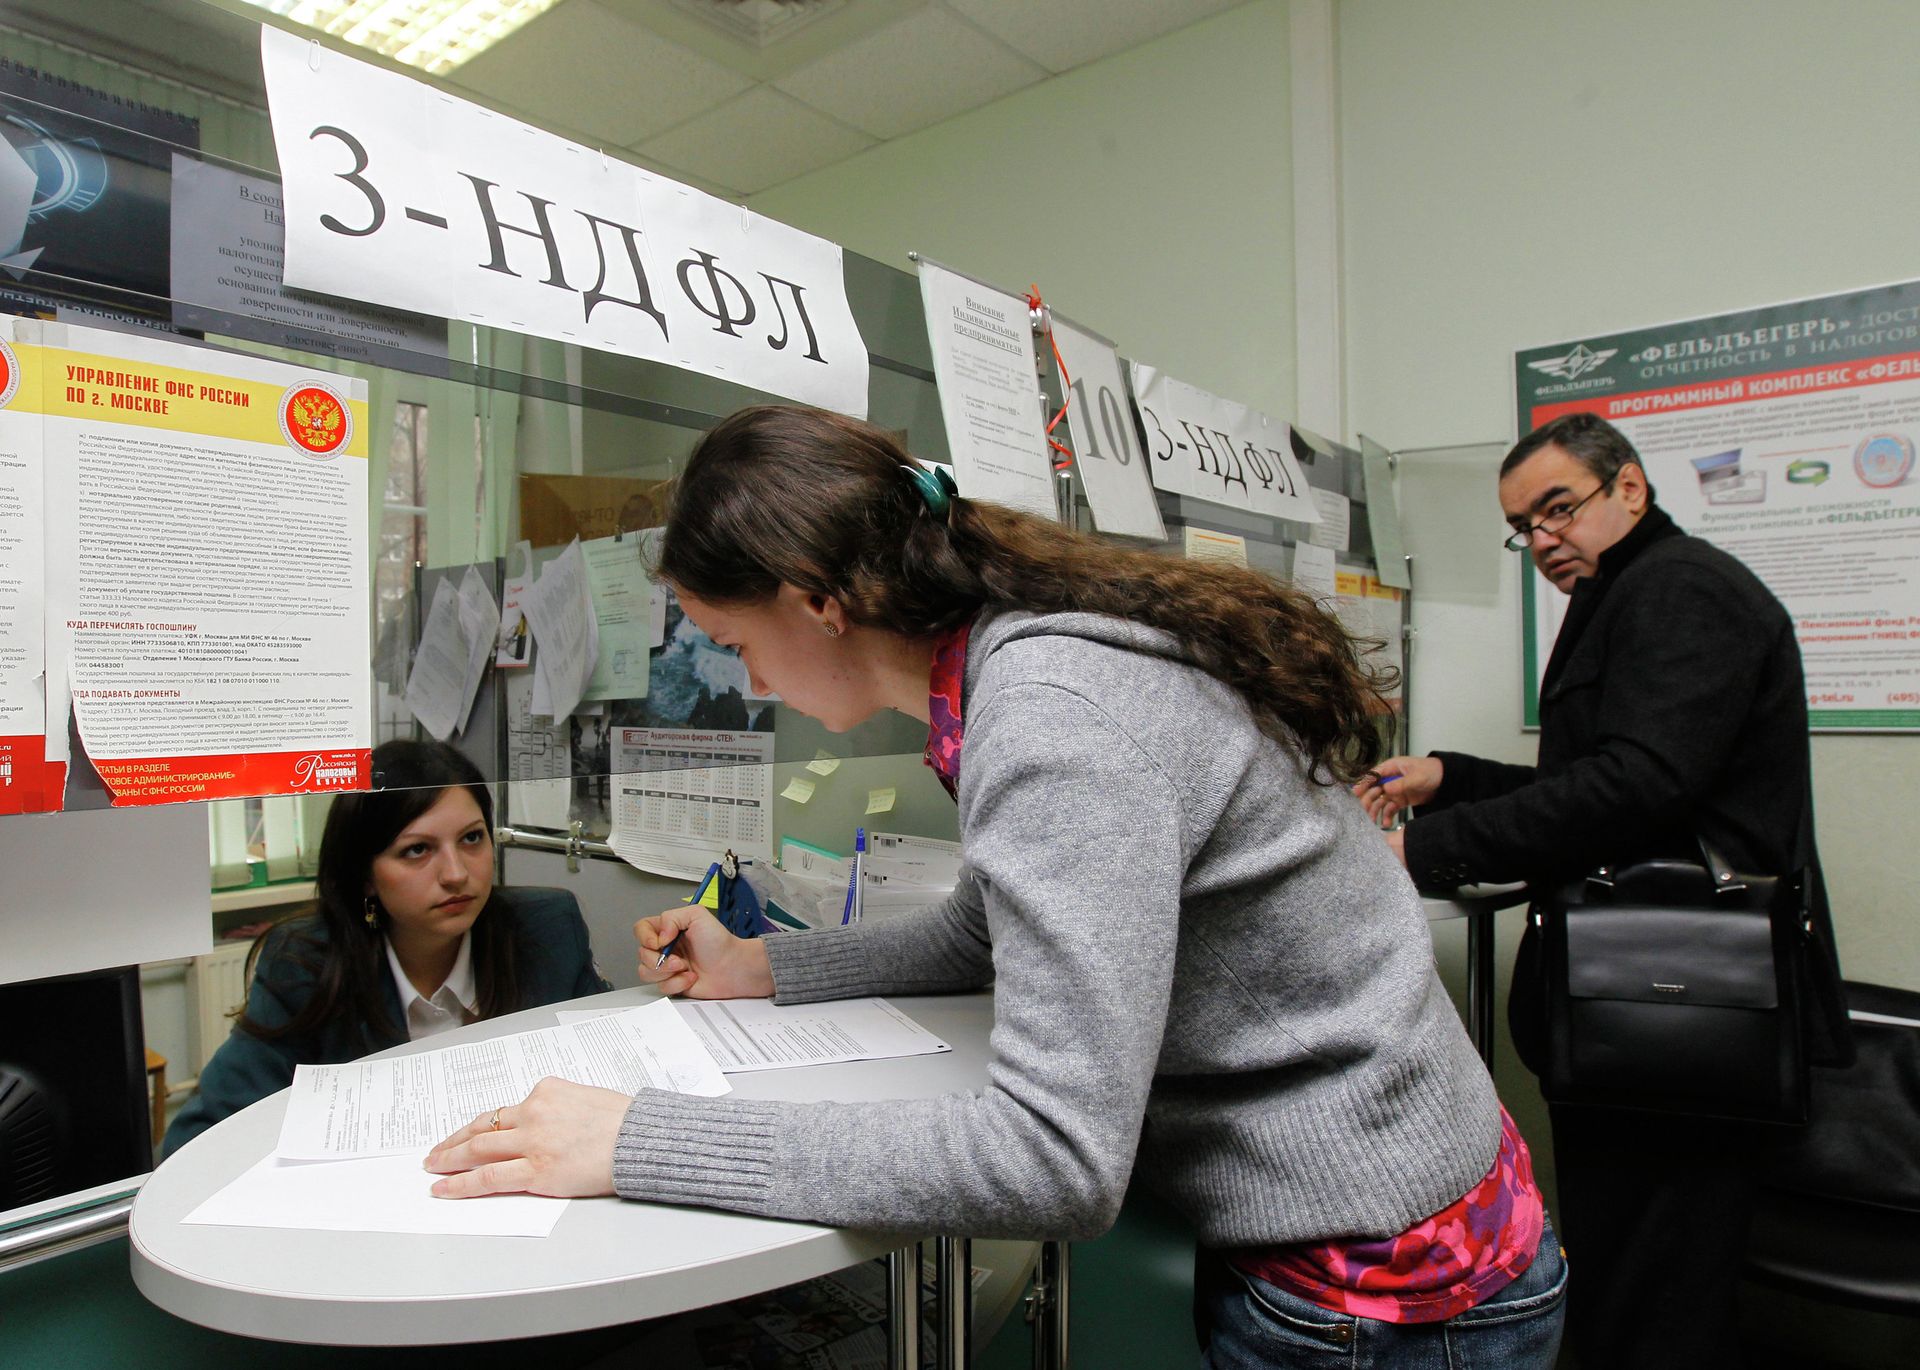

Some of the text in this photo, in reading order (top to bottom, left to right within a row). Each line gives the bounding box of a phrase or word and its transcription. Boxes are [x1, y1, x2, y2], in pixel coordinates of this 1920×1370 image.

[240, 186, 249, 198] В
[264, 208, 284, 223] На
[310, 124, 829, 364] 3-НДФЛ
[218, 276, 276, 296] основании
[238, 295, 314, 318] доверенности
[316, 311, 336, 323] или
[338, 316, 408, 338] доверенности,
[952, 306, 1020, 339] Индивидуальные
[966, 296, 1005, 320] Внимание
[954, 323, 1023, 354] предприниматели
[1629, 317, 1850, 363] «ФЕЛЬДЪЕГЕРЬ»
[1640, 348, 1772, 378] ОТЧЕТНОСТЬ
[1785, 344, 1796, 358] В
[66, 365, 250, 408] УПРАВЛЕНИЕ ФНС РОССИИ
[66, 386, 169, 415] ПО г. МОСКВЕ
[1610, 381, 1744, 414] ПРОГРАММНЫЙ
[1750, 368, 1850, 395] КОМПЛЕКС
[1070, 377, 1130, 466] 10
[1144, 406, 1298, 499] 3-НДФЛ
[66, 621, 197, 631] КУДА ПЕРЕЧИСЛЯТЬ ГОСПОШЛИНУ
[92, 690, 132, 699] ПОДАВАТЬ
[134, 690, 181, 698] ДОКУМЕНТЫ
[126, 765, 132, 773] В
[134, 764, 170, 773] РАЗДЕЛЕ
[133, 772, 235, 785] АДМИНИСТРИРОВАНИЕ»
[149, 786, 168, 795] ФНС
[170, 784, 205, 794] РОССИИ
